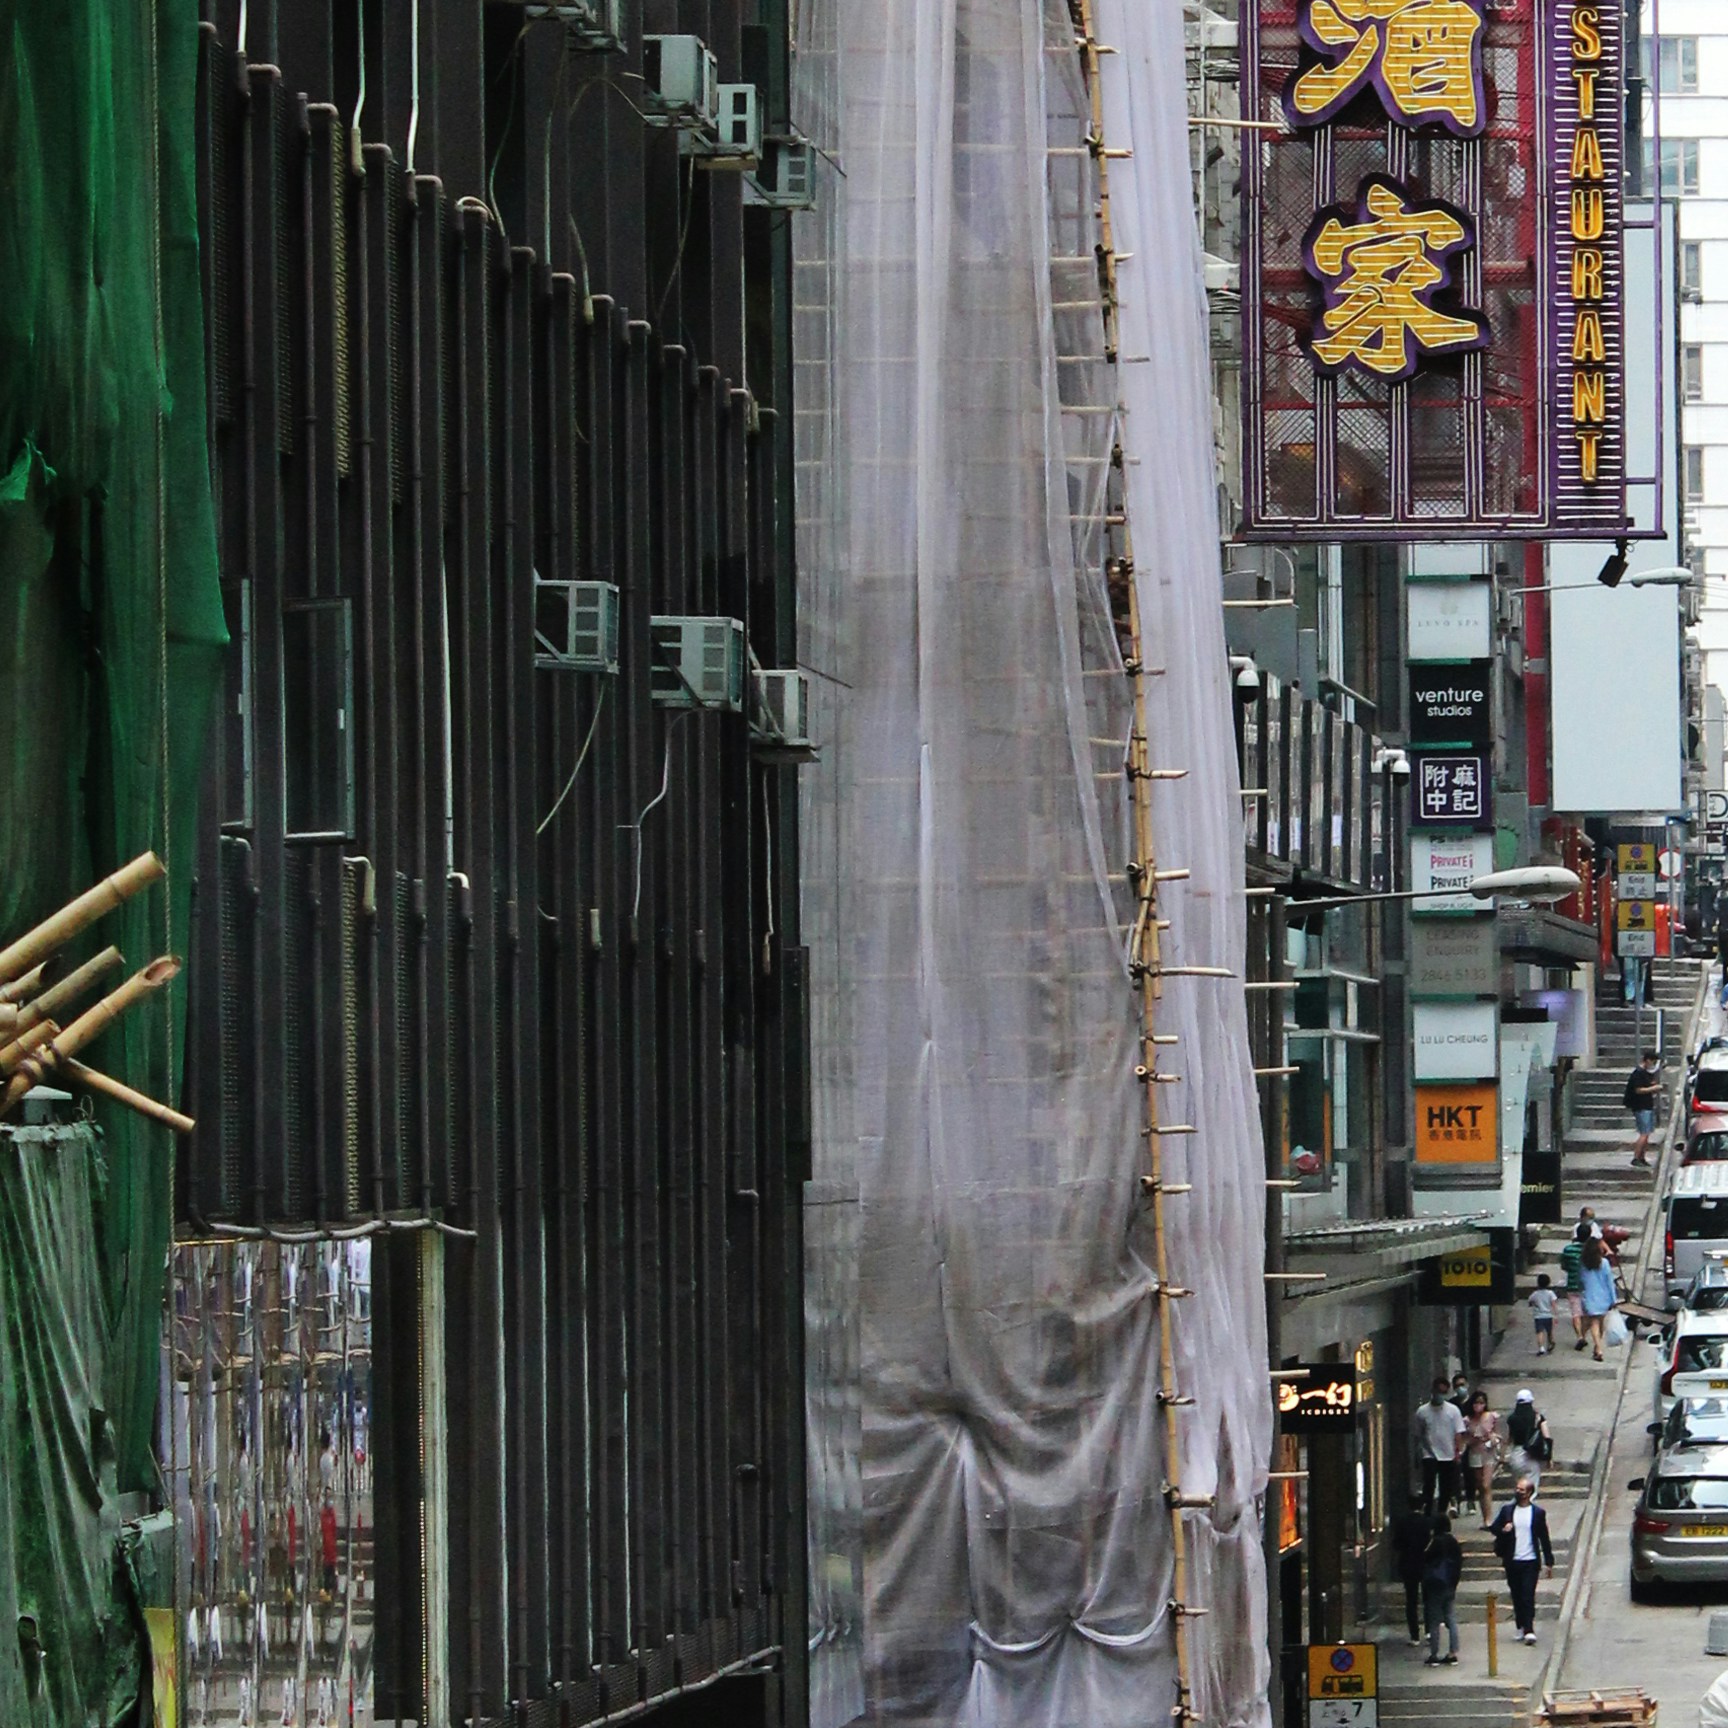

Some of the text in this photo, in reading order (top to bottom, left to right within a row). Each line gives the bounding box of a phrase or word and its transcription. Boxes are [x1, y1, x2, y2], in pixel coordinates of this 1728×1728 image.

[1415, 687, 1484, 703] venture
[1427, 705, 1473, 717] studios
[1430, 854, 1468, 869] PRIVATE
[1430, 875, 1468, 890] PRIVATE
[1446, 1034, 1489, 1045] CHEUNG
[1427, 1105, 1483, 1128] HKT
[1443, 1260, 1488, 1276] 1010
[1352, 1701, 1363, 1718] 7
